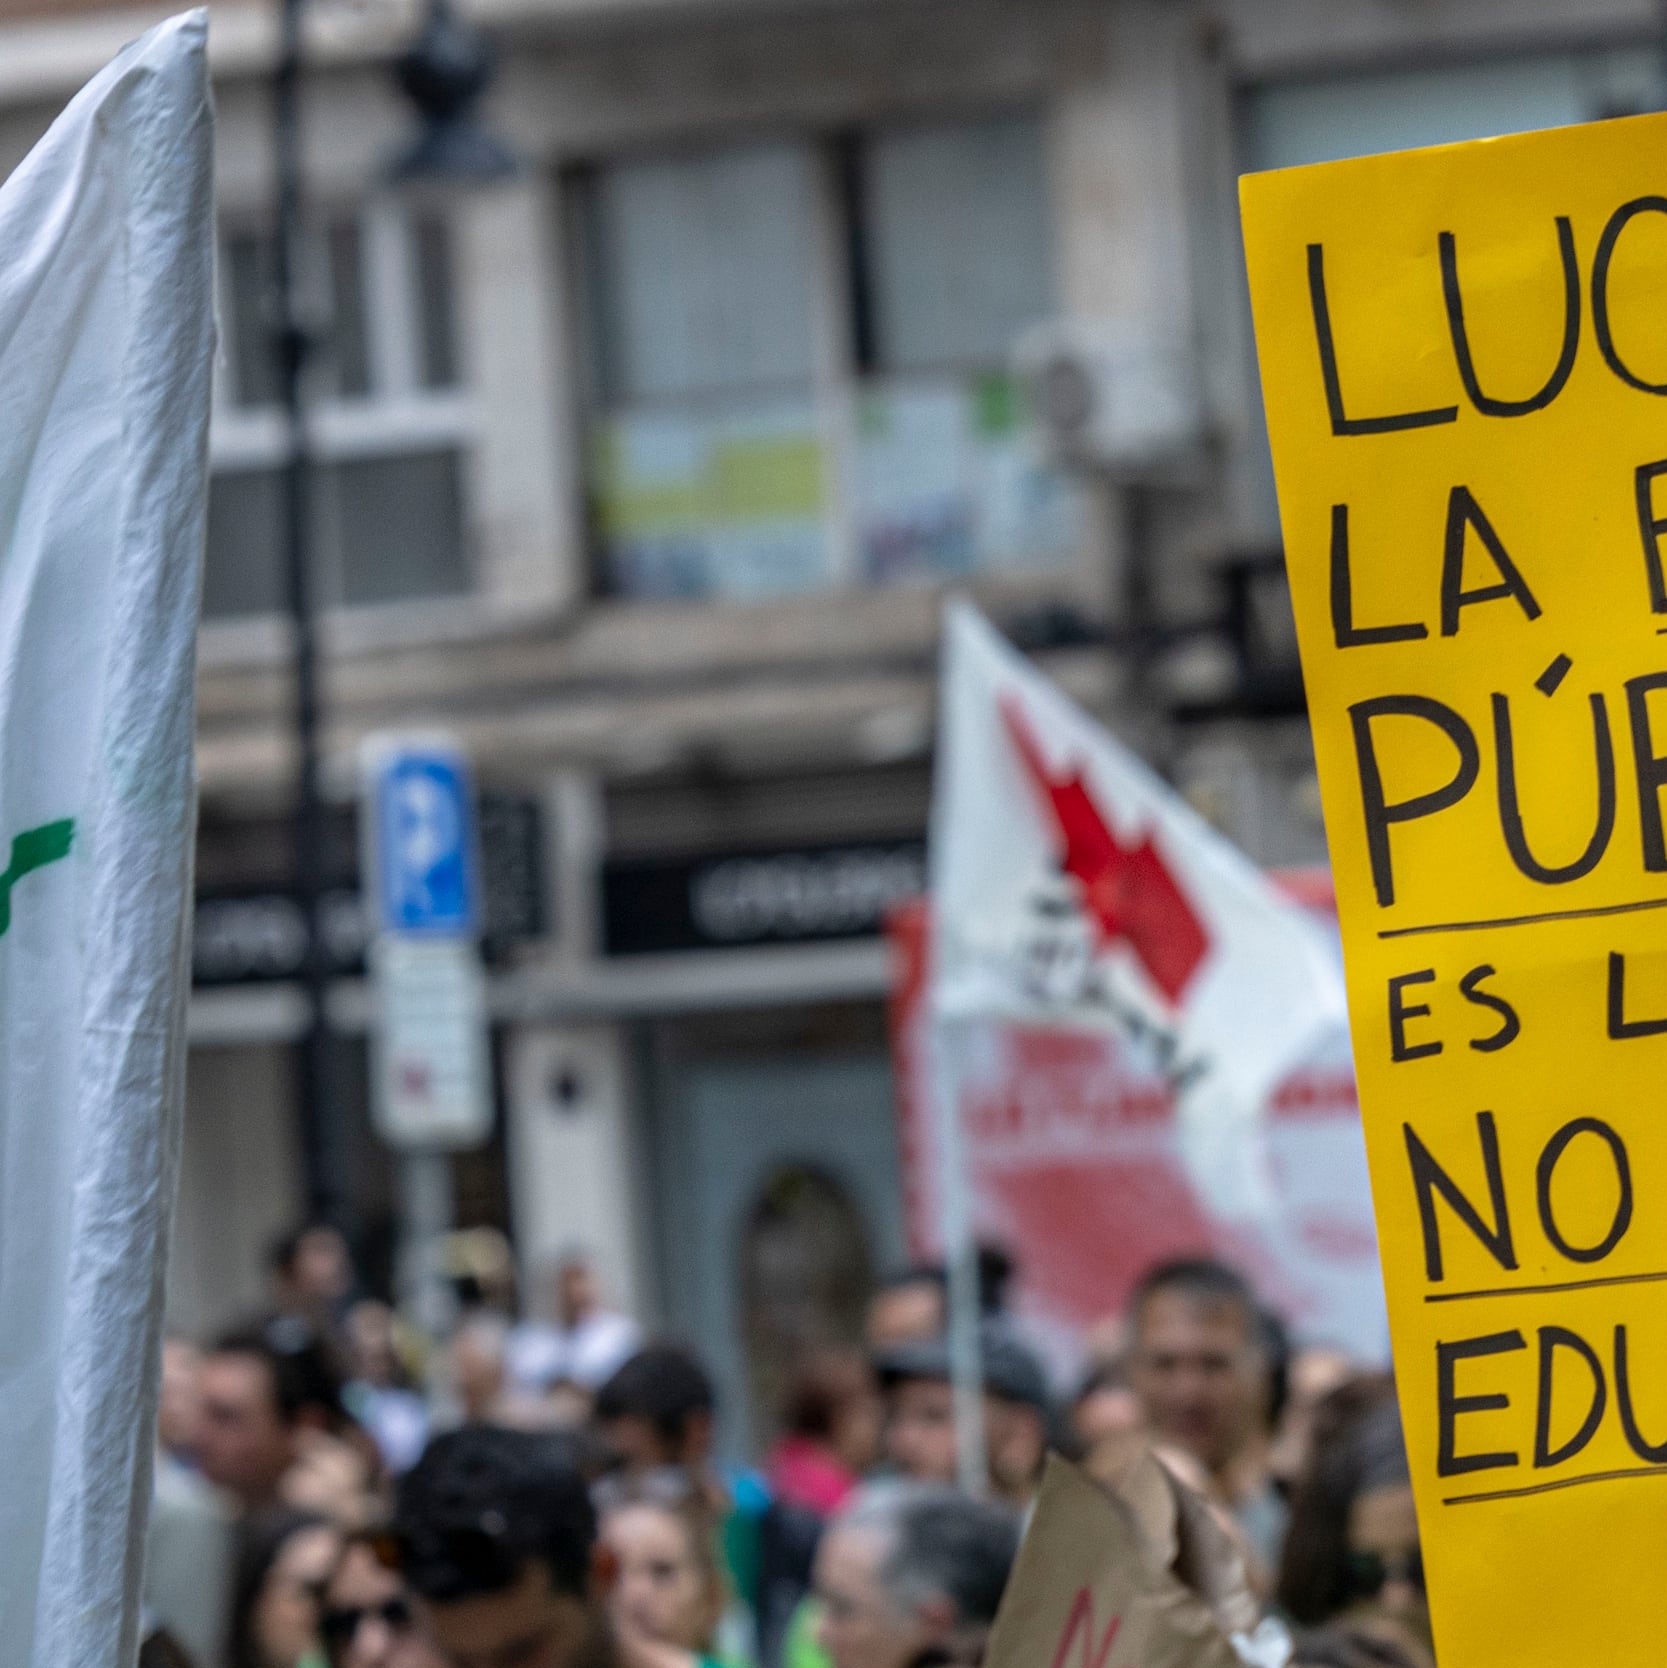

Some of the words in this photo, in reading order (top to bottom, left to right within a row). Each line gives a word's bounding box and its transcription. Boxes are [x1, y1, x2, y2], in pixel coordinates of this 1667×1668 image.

[1328, 484, 1544, 651] LA
[1387, 963, 1522, 1064] ES
[1401, 1109, 1635, 1284] NO
